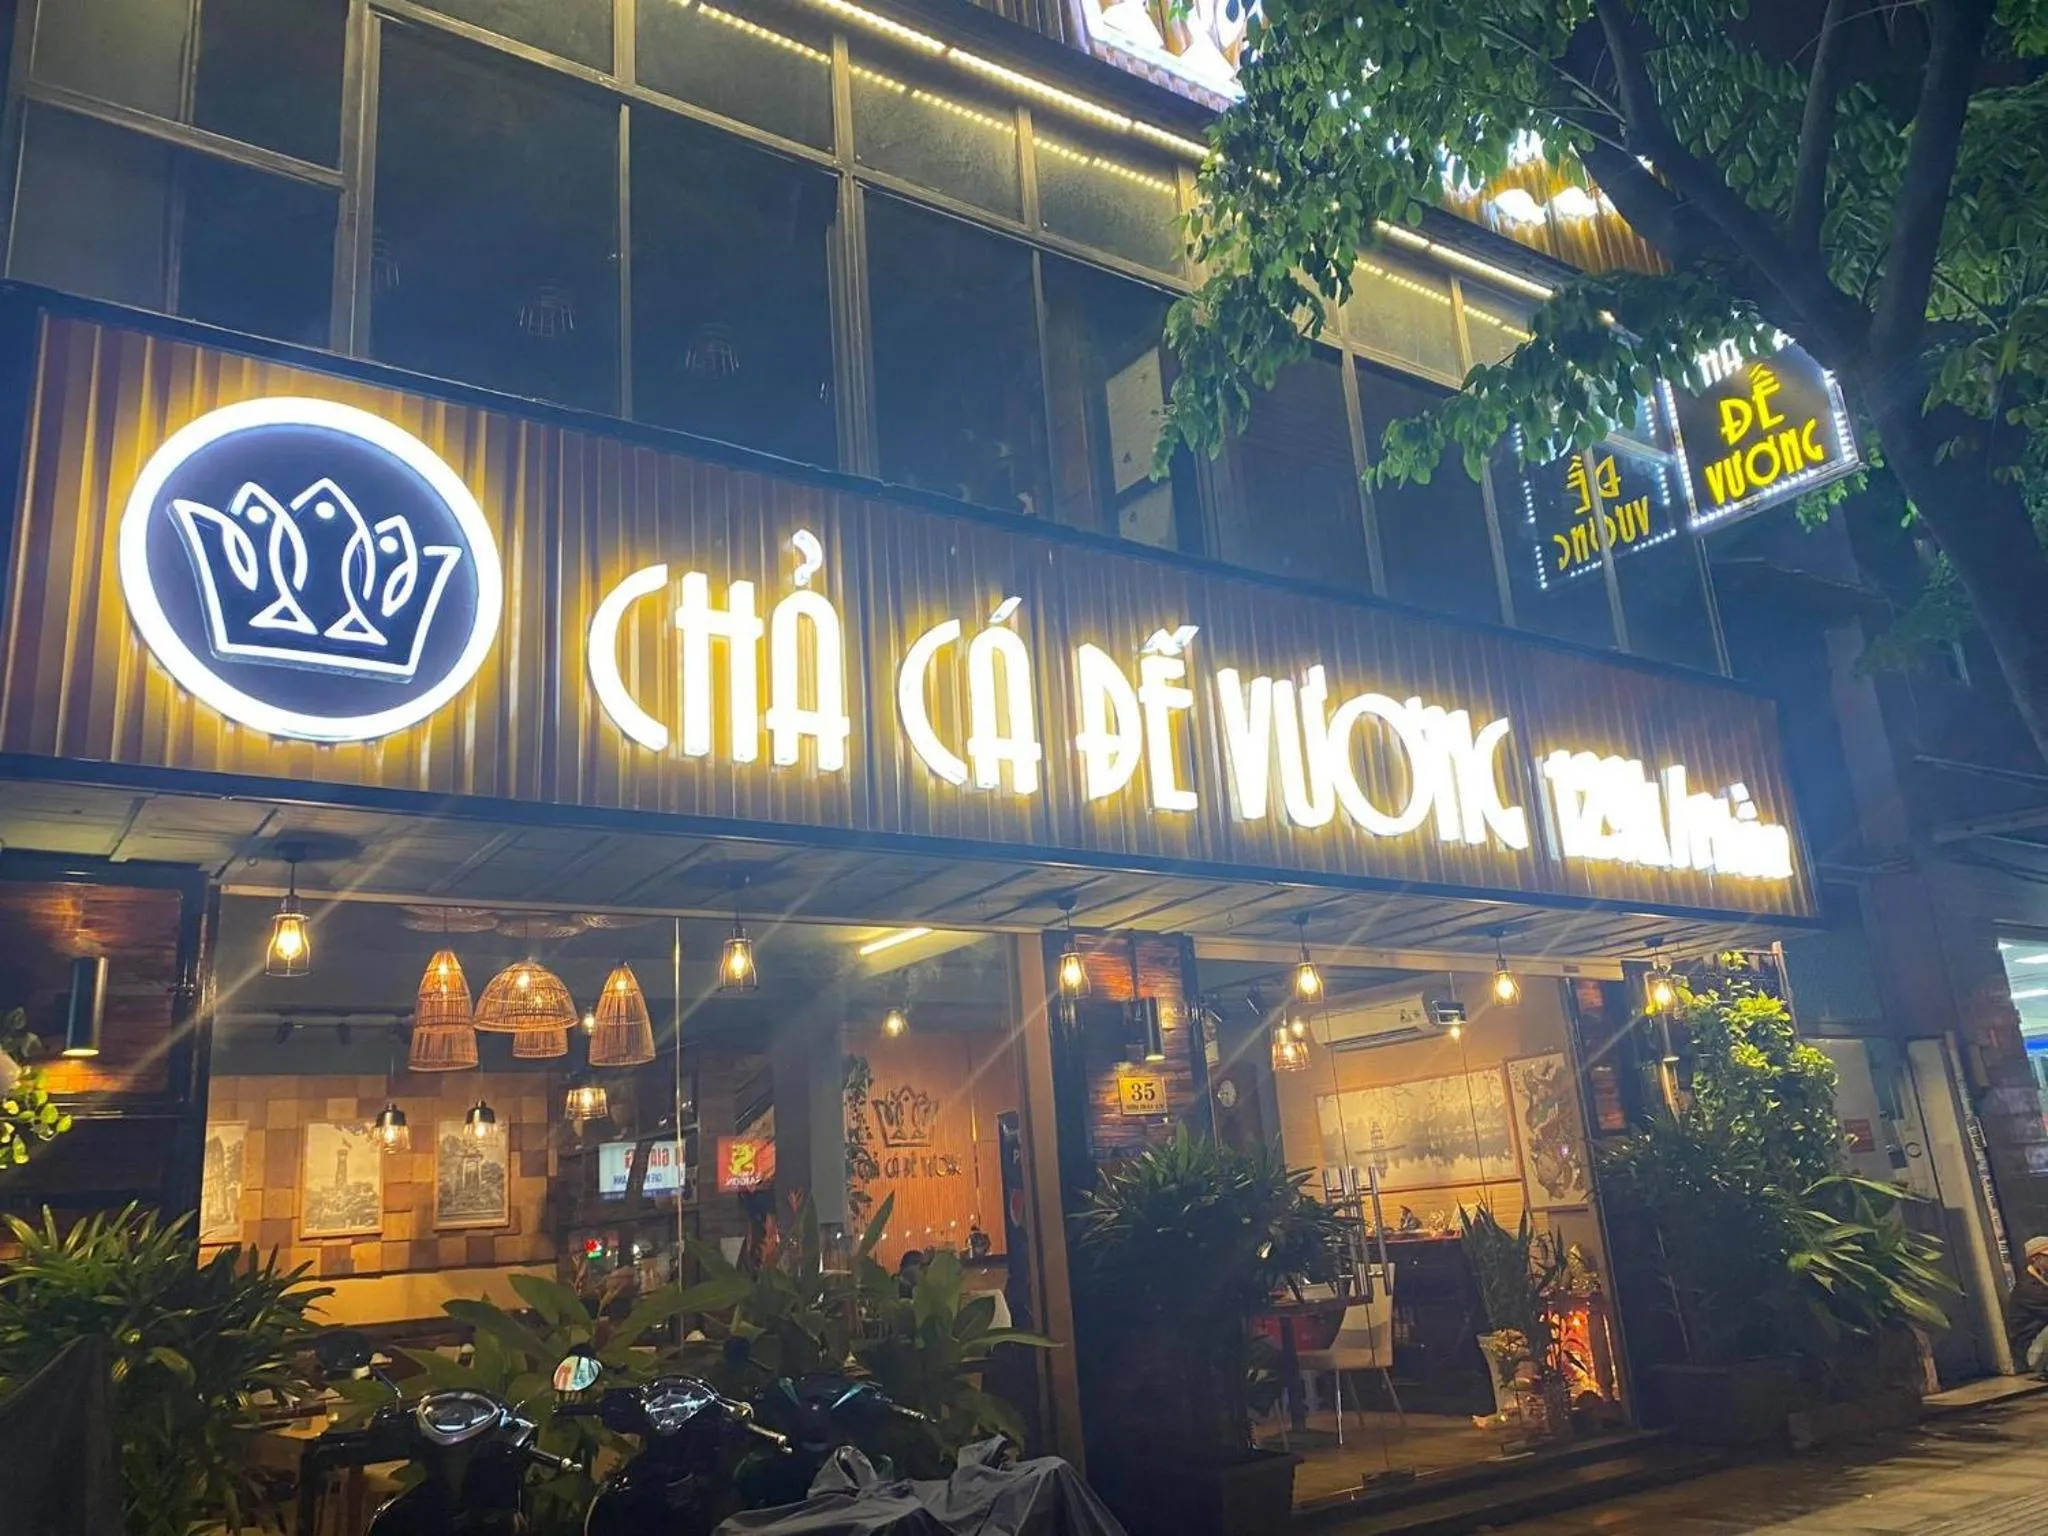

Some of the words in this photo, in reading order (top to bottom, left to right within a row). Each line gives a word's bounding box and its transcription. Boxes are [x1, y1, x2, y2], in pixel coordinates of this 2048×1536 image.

[1704, 418, 1824, 505] VƯƠNG
[588, 528, 850, 771] CHẢ
[899, 596, 1041, 795] CÁ
[1075, 625, 1199, 811] ĐẾ
[1217, 664, 1528, 850] VƯƠNG
[1131, 1082, 1155, 1102] 35
